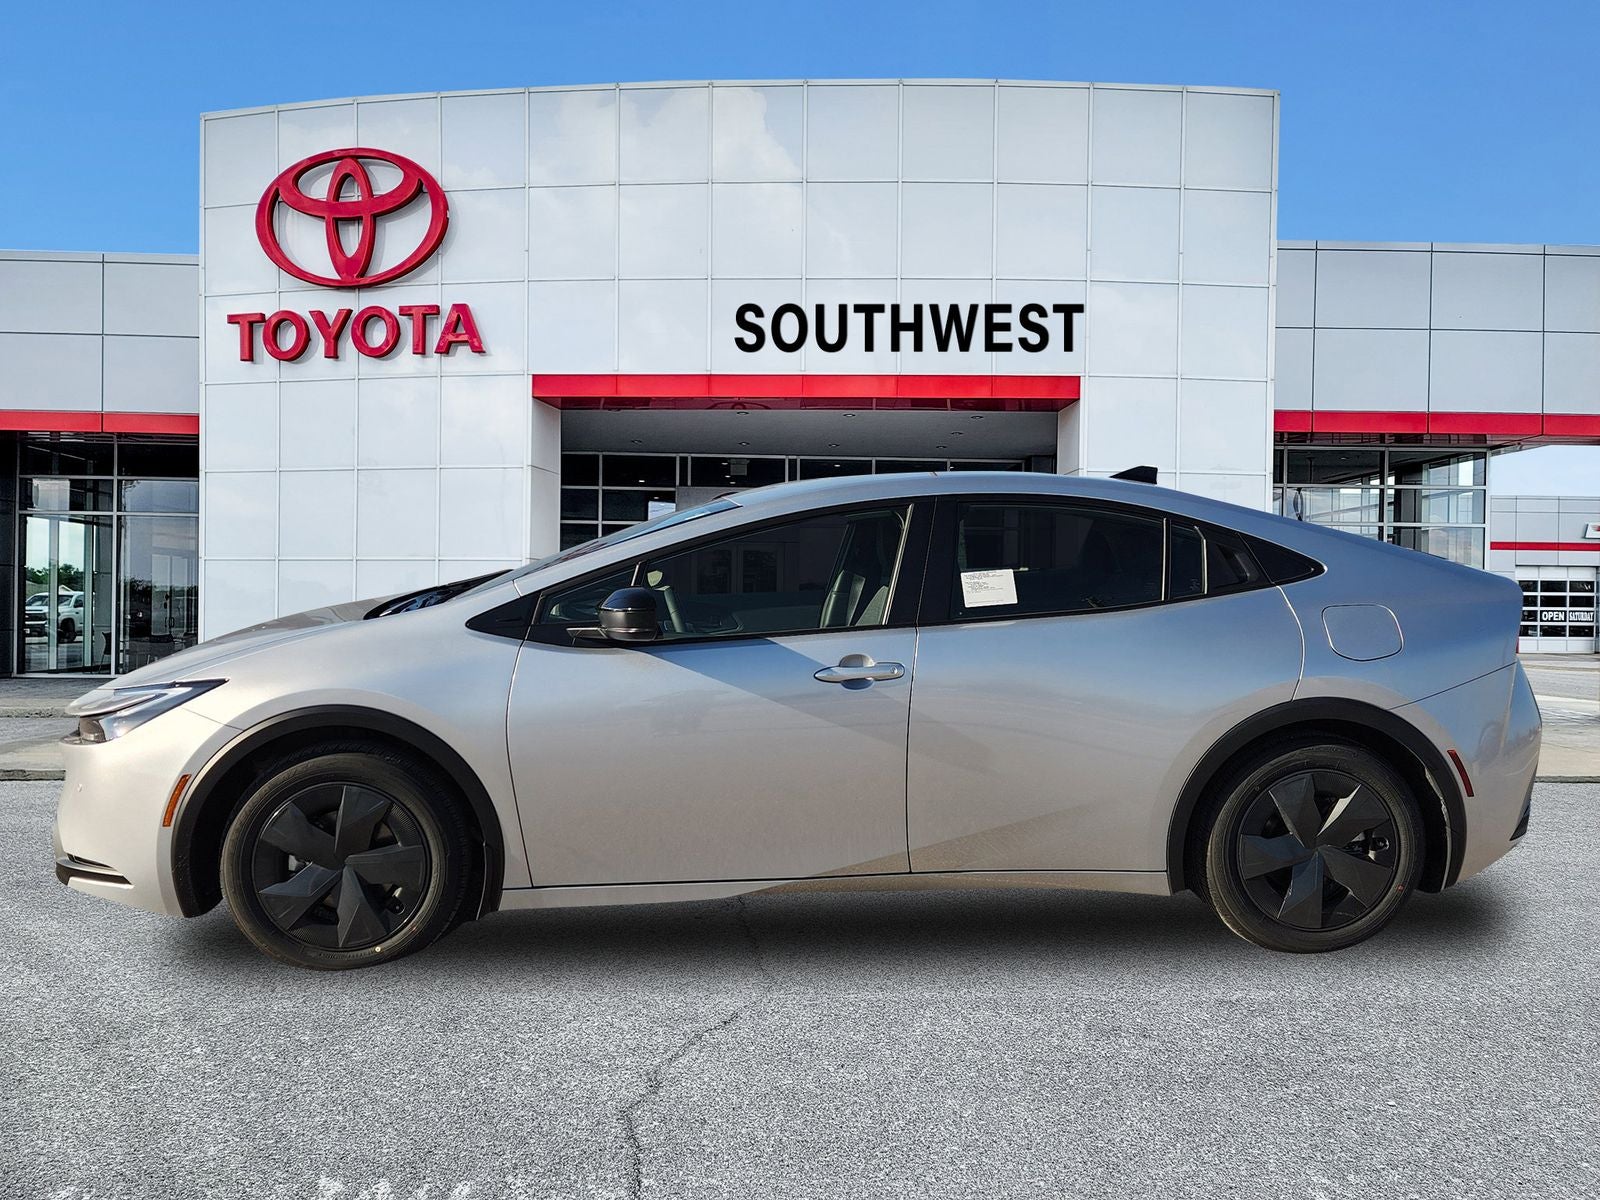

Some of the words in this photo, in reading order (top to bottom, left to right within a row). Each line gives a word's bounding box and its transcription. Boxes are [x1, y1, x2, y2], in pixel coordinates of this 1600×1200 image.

[227, 303, 486, 362] TOYOTA
[734, 303, 1084, 353] SOUTHWEST
[1541, 611, 1565, 621] OPEN
[1569, 611, 1594, 621] SATURDAY
